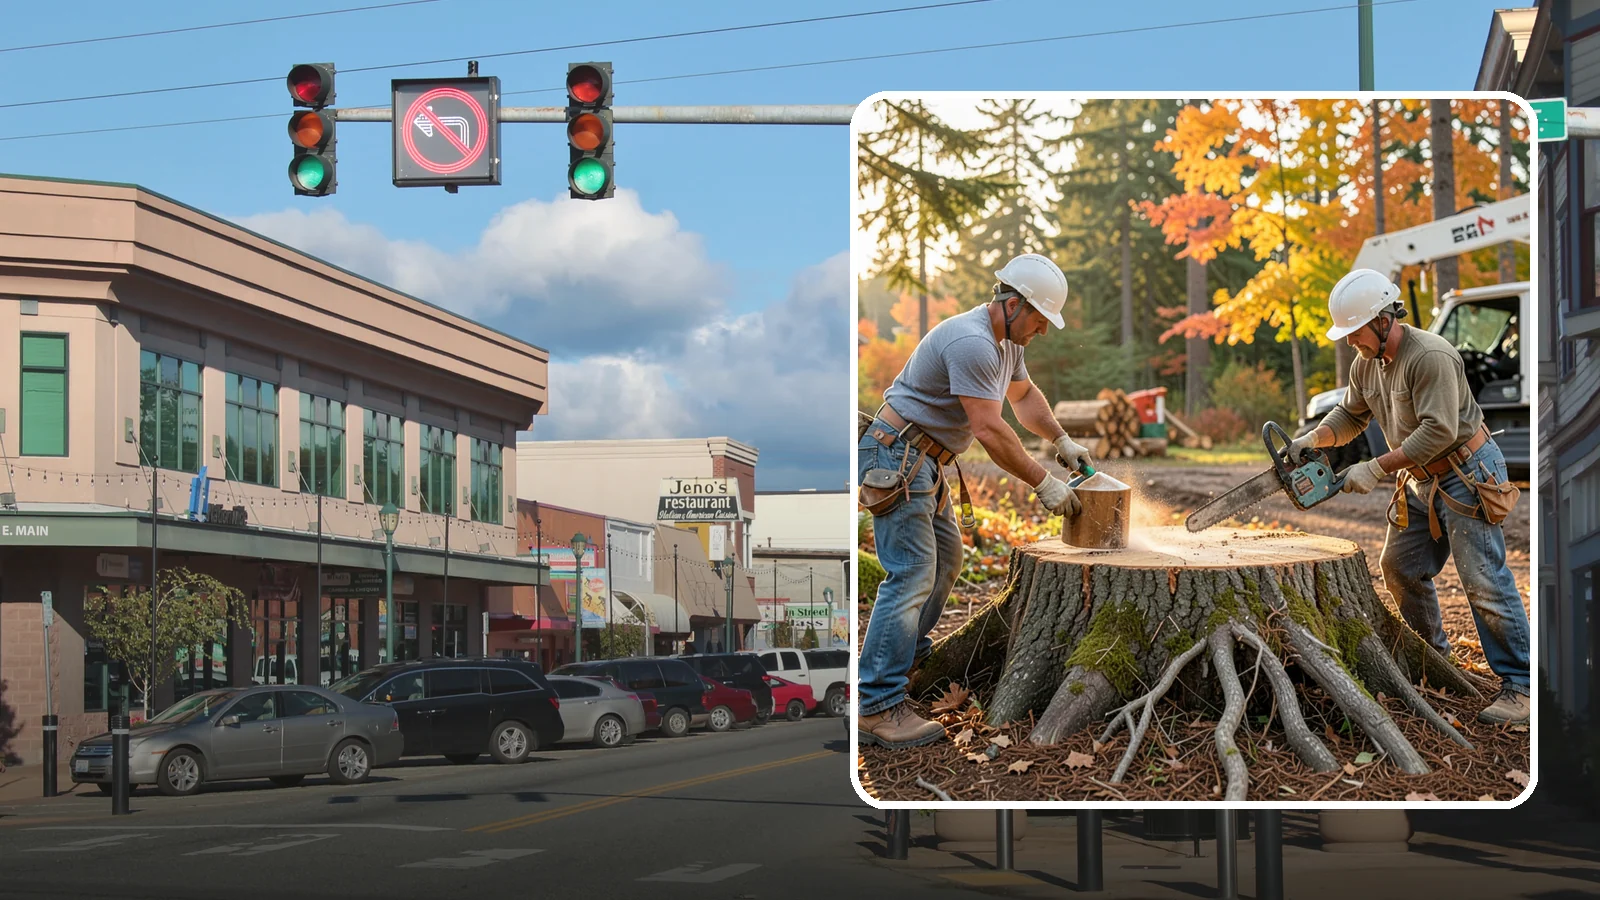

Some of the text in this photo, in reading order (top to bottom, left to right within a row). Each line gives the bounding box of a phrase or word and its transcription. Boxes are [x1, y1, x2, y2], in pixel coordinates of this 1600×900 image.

[669, 480, 727, 495] Jeno's
[665, 496, 731, 509] restaurant
[658, 509, 682, 520] Italian
[686, 509, 714, 519] American
[715, 509, 738, 519] Cuisine
[2, 525, 49, 536] E. MAIN
[797, 607, 828, 617] Street
[787, 618, 824, 627] lass
